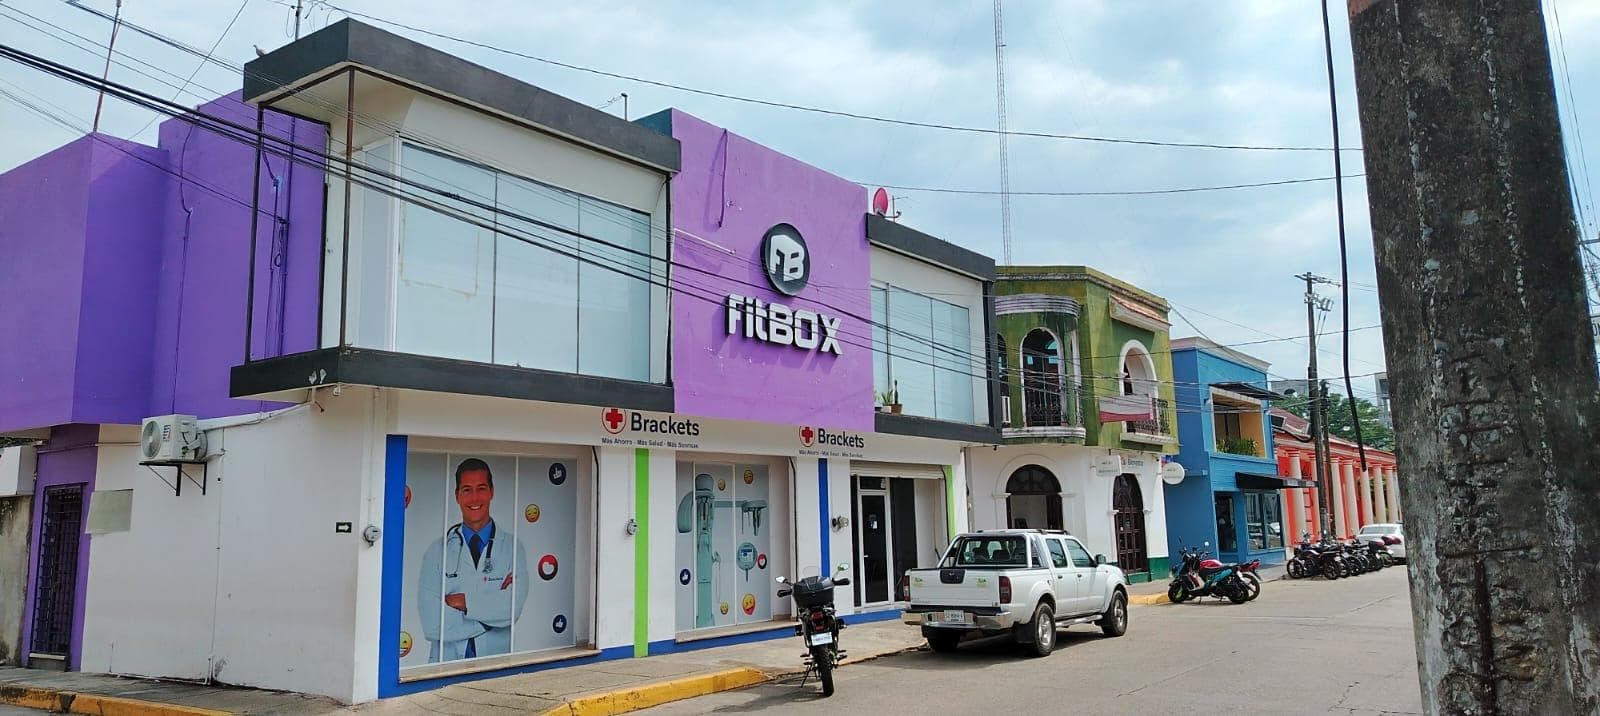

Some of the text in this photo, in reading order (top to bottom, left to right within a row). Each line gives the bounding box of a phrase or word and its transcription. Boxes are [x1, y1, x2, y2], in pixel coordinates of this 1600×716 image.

[769, 234, 805, 282] FB
[631, 411, 700, 436] Brackets
[818, 428, 865, 448] Brackets
